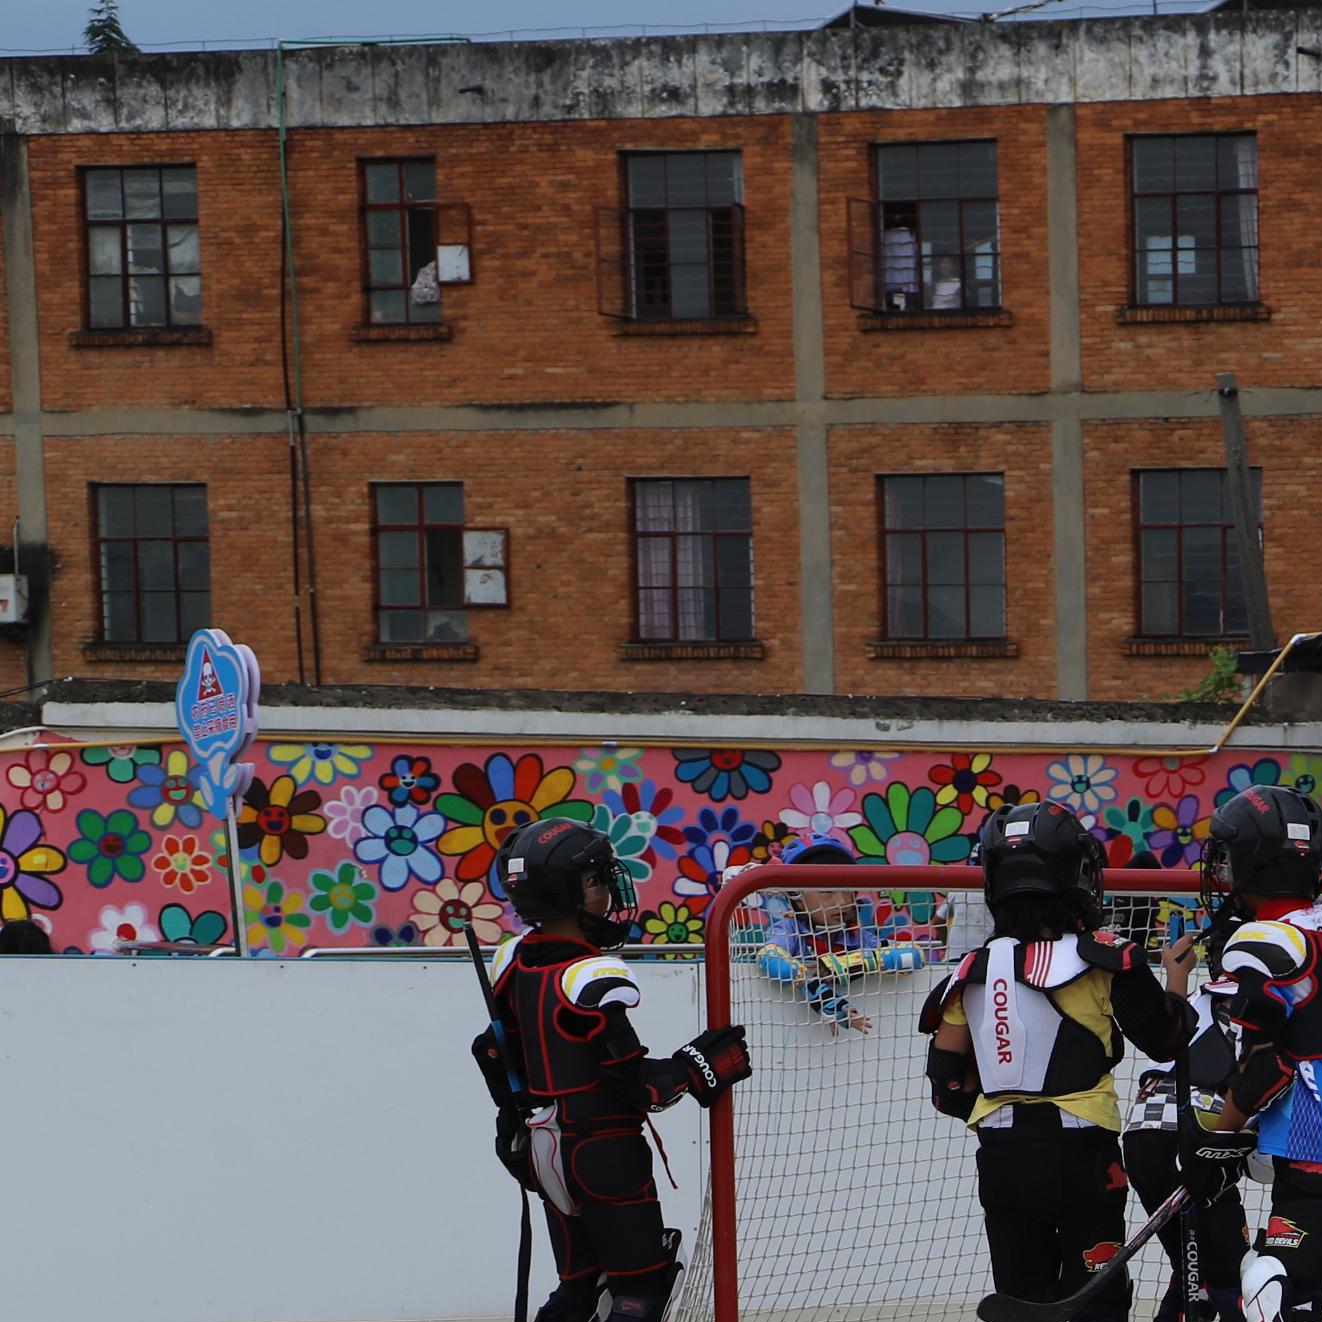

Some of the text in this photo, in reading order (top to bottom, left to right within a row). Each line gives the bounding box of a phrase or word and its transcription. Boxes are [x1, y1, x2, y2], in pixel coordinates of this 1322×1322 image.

[993, 978, 1012, 1065] COUGAR
[682, 1044, 717, 1088] COUGAR
[1274, 1237, 1299, 1246] DEVILS
[1187, 1241, 1200, 1303] COUGAR
